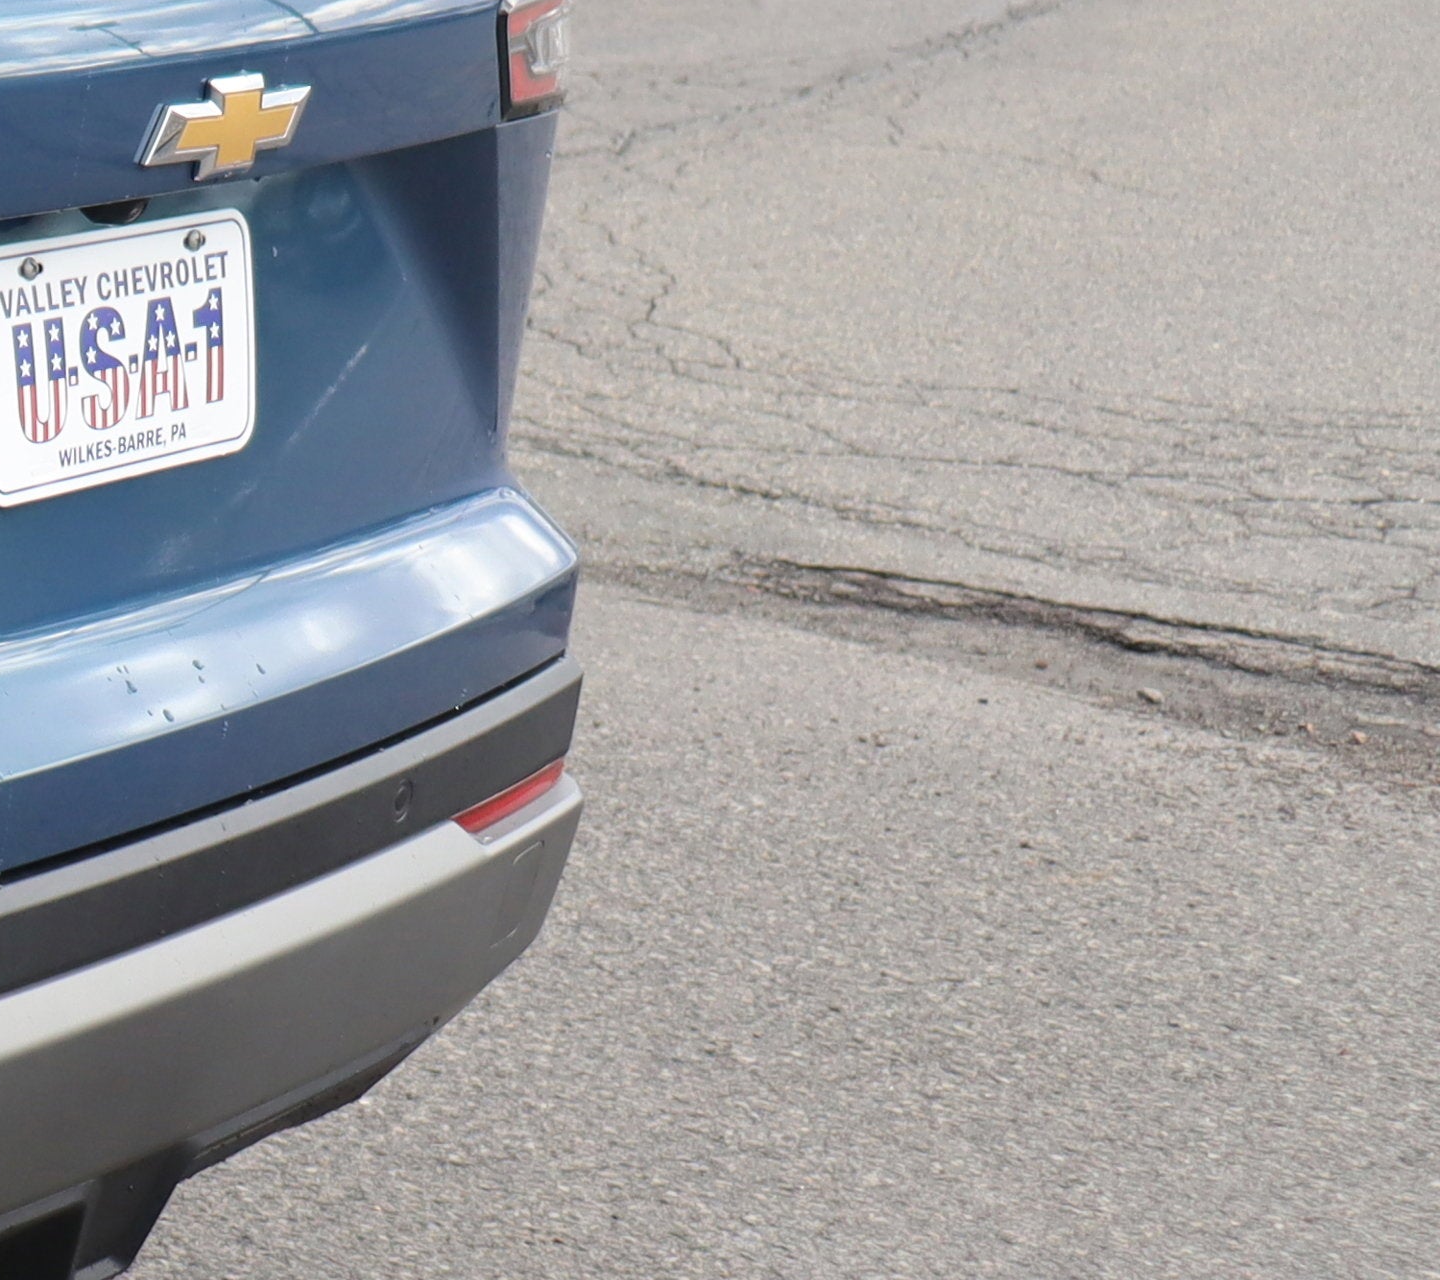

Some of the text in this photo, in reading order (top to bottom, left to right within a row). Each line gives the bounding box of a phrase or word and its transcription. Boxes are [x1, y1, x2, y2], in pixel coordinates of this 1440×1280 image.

[96, 250, 229, 301] CHEVROLET
[58, 422, 187, 468] WILKES-BARRE, PA
